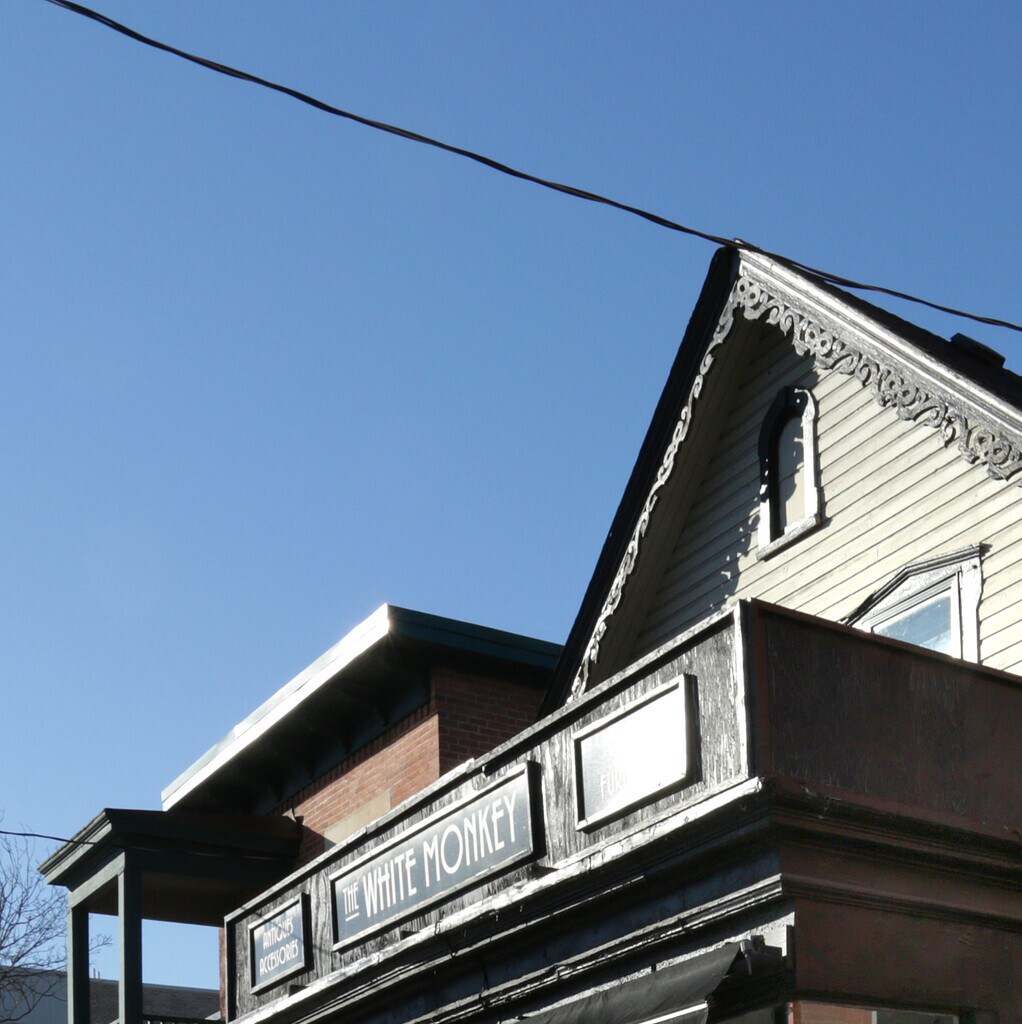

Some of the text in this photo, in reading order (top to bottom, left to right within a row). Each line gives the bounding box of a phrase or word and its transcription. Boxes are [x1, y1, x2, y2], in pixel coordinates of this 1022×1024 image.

[342, 791, 517, 918] THE WHITE MONKEY
[263, 917, 294, 950] ANTIQUES
[260, 939, 298, 976] ACCESSORIES
